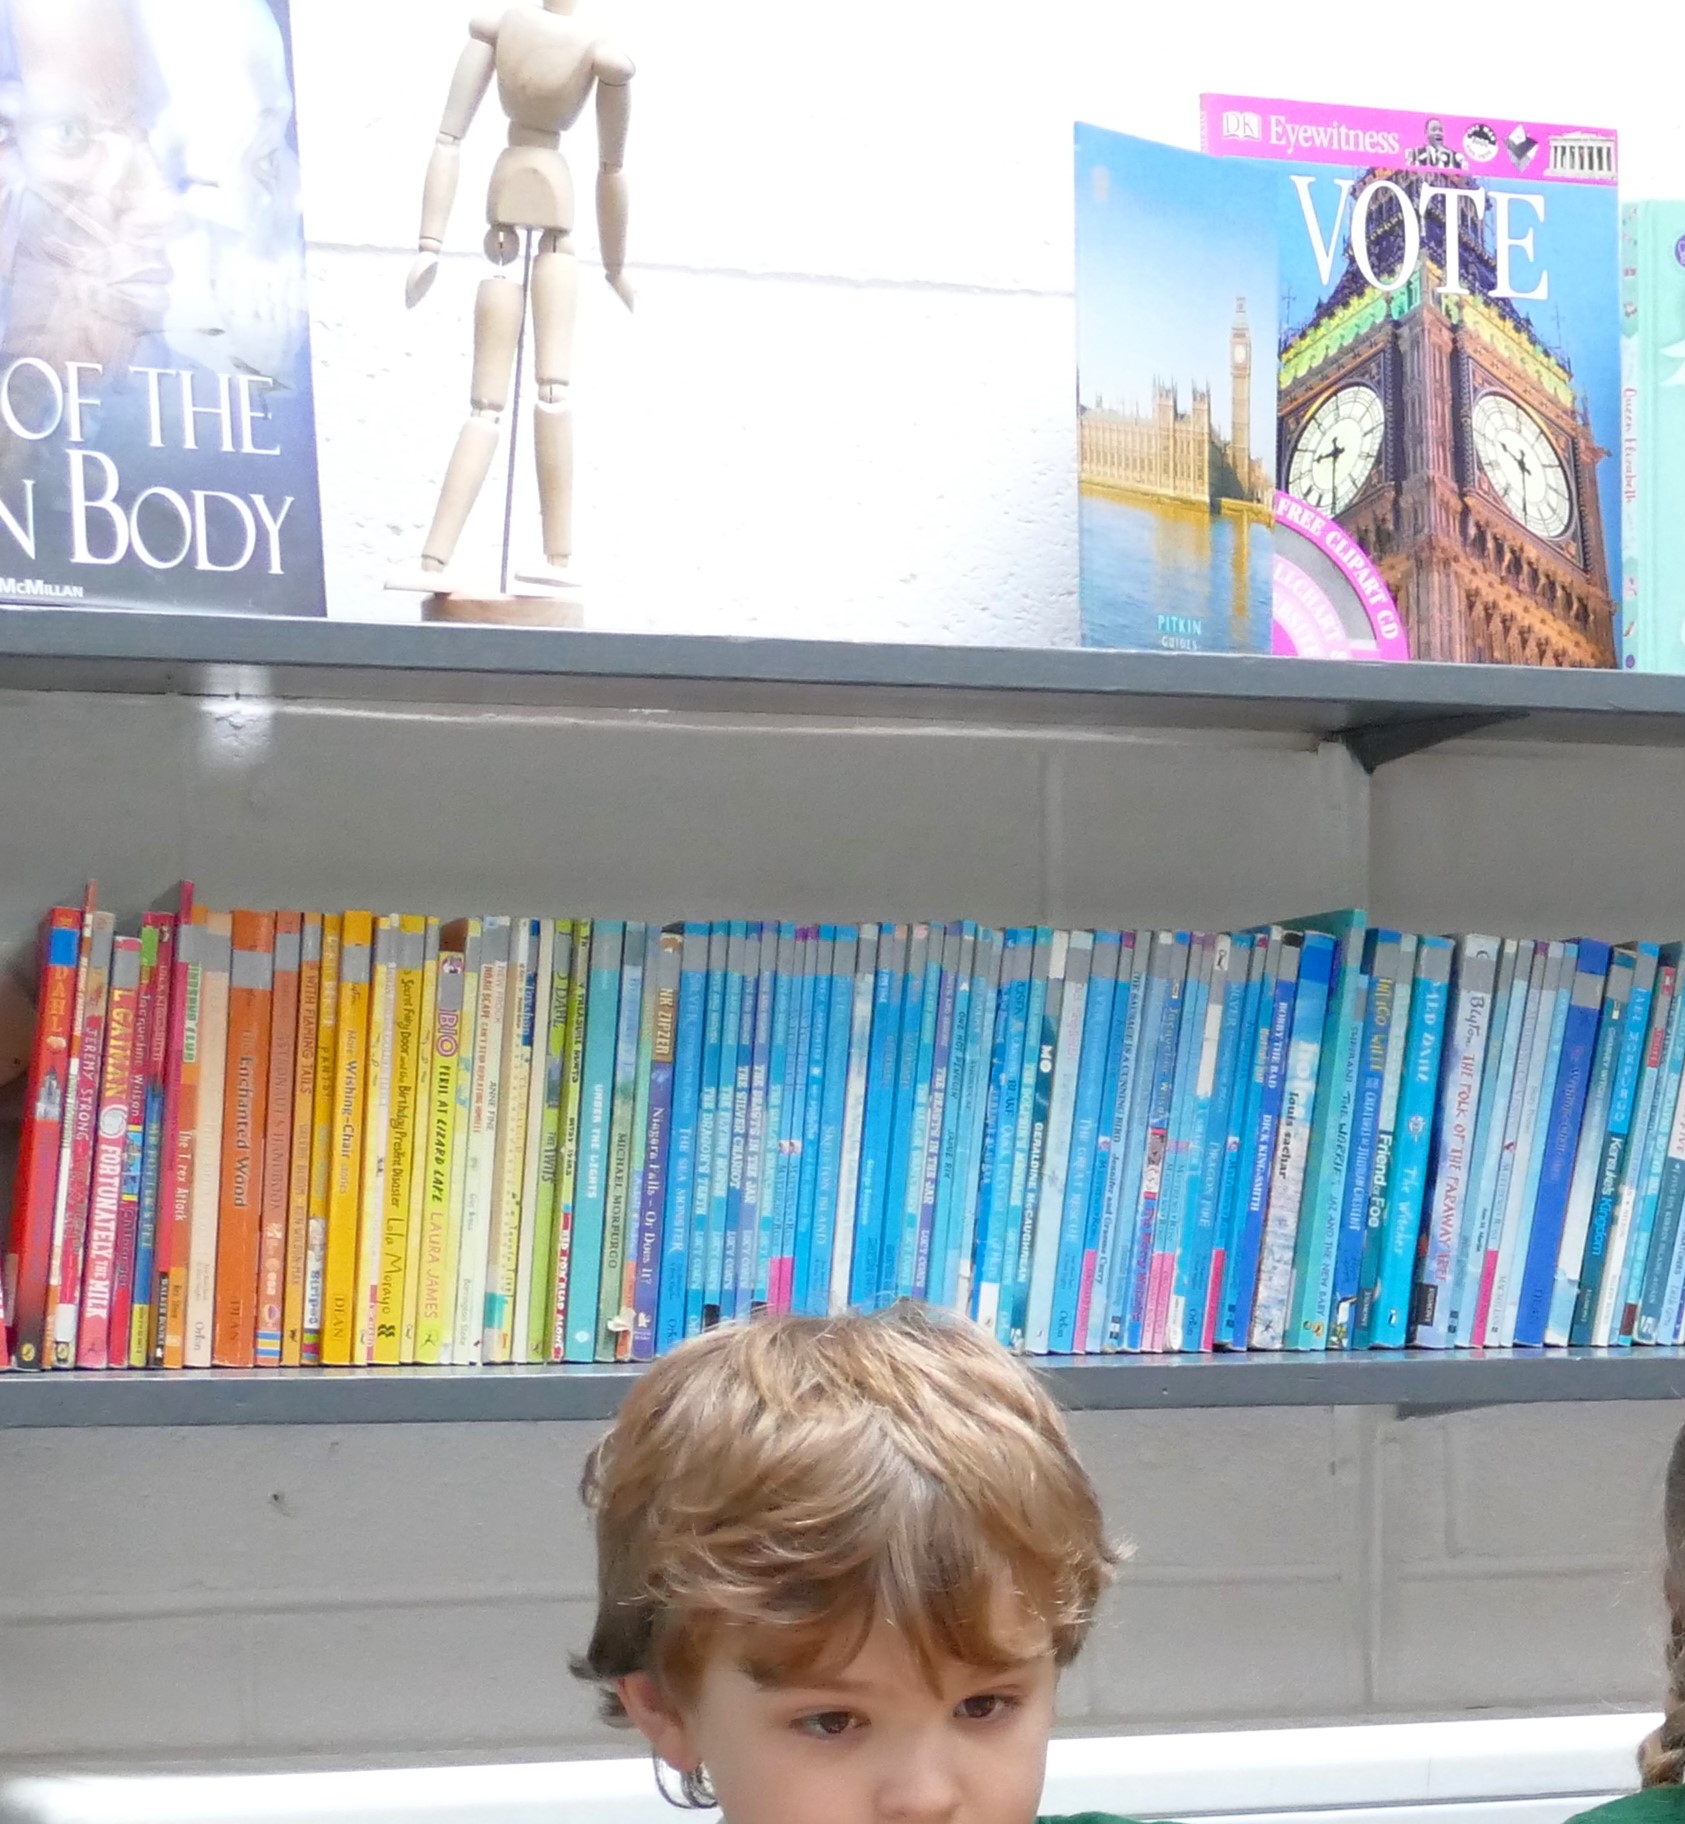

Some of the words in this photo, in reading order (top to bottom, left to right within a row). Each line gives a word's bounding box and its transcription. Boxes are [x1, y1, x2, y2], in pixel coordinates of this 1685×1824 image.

[1270, 114, 1399, 155] Eyewitness
[1289, 174, 1548, 299] VOTE
[2, 356, 103, 442] OF
[128, 365, 281, 455] THE
[1276, 498, 1322, 536] FREE
[1325, 530, 1384, 604] CLIPART
[1377, 610, 1399, 640] CD
[1158, 615, 1201, 635] PITKIN
[1161, 636, 1197, 650] GUIDES
[81, 1028, 98, 1082] JEREMY
[104, 1007, 129, 1100] GAIMAN
[1459, 1054, 1477, 1081] THE
[74, 1088, 94, 1142] STRONG
[233, 1055, 253, 1150] Enchanted
[339, 1060, 358, 1159] Wishing-Chair
[1284, 1091, 1300, 1128] louis
[1455, 1083, 1474, 1118] FOLK
[1259, 1114, 1273, 1142] DICK
[1452, 1124, 1468, 1144] OF
[232, 1155, 249, 1208] Wood
[612, 1133, 626, 1190] MICHAEL
[1025, 1122, 1044, 1190] GERALDINE
[1249, 1144, 1271, 1211] KING-SMITH
[1276, 1132, 1294, 1180] sachar
[1372, 1134, 1393, 1186] Friend
[1447, 1148, 1465, 1173] THE
[1601, 1137, 1624, 1196] Kensuke's
[382, 1217, 404, 1245] Lola
[426, 1211, 444, 1264] LAURA
[608, 1195, 624, 1269] MORPURGO
[1367, 1198, 1386, 1228] Foe
[1437, 1176, 1462, 1247] FARAWAY
[1590, 1197, 1617, 1256] Kingdom
[84, 1279, 109, 1319] MILK
[423, 1268, 440, 1318] JAMES
